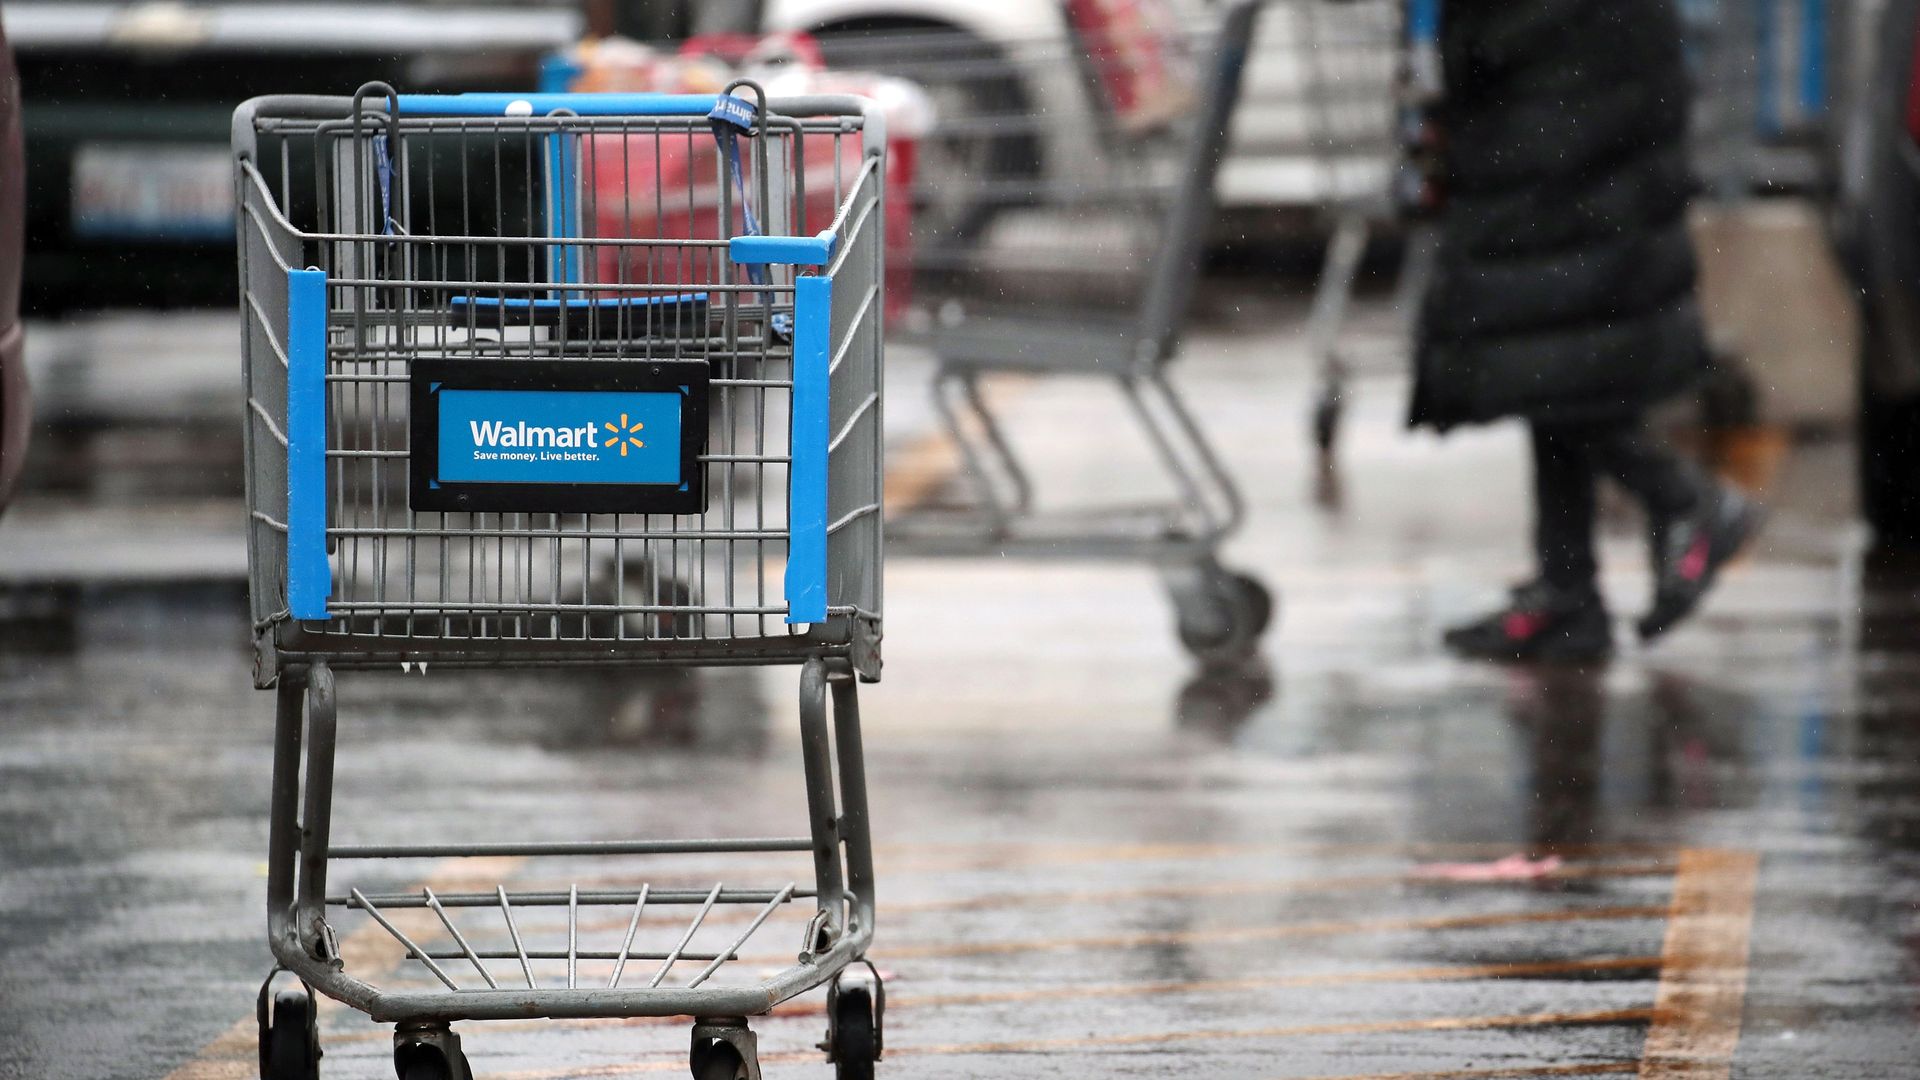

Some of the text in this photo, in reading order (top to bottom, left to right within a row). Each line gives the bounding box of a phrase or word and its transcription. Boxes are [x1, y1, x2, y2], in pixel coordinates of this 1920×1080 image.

[469, 420, 598, 448] Walmart
[473, 450, 600, 462] Save money. Live better.
